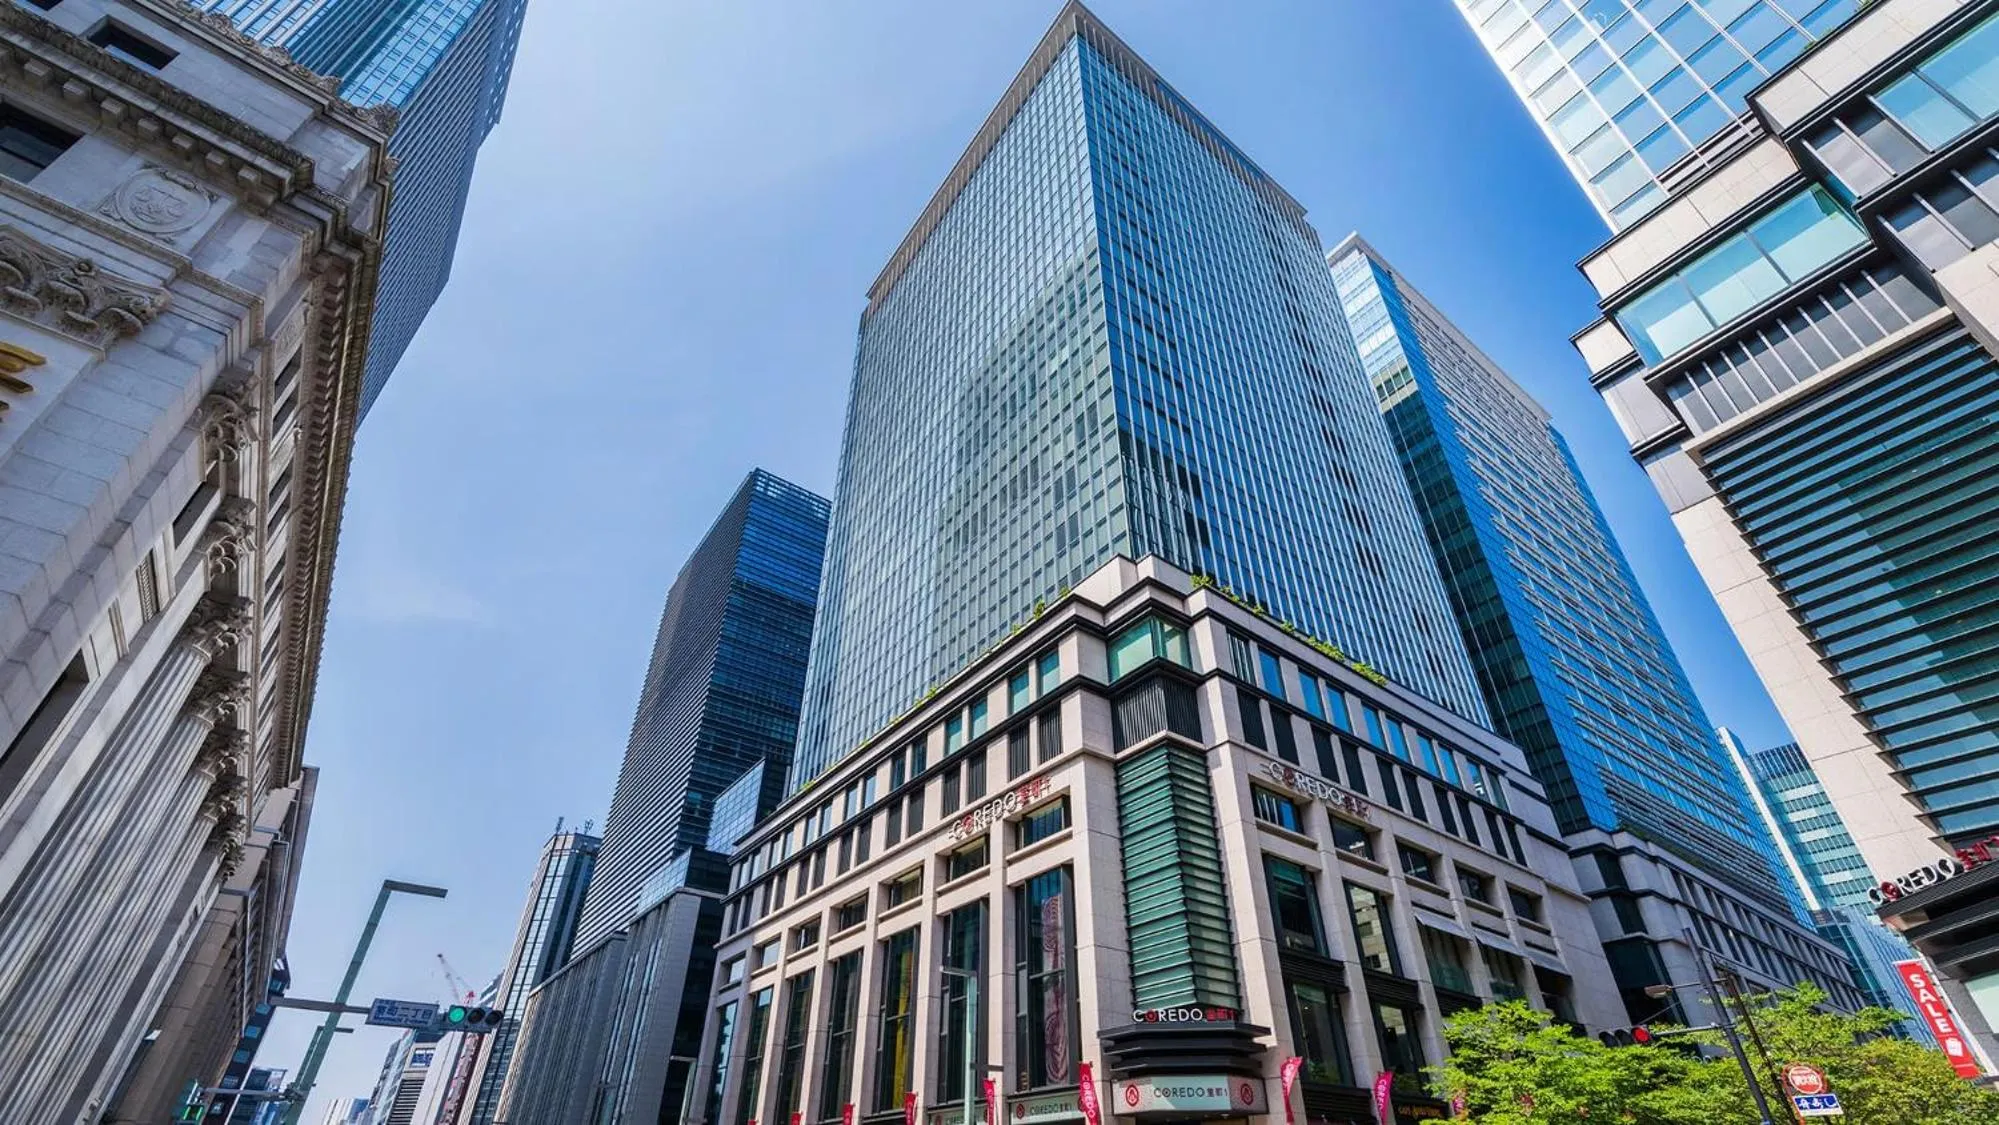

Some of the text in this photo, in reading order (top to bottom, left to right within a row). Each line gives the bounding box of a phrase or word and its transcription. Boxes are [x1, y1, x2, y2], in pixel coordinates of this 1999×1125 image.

[1268, 762, 1342, 805] COREDO
[952, 791, 1017, 839] COREDO
[1867, 857, 1955, 905] COREDO
[1133, 1008, 1203, 1023] COREDO
[1909, 973, 1952, 1033] SALE
[1081, 1073, 1097, 1119] COREDO
[1153, 1086, 1205, 1098] COREDO
